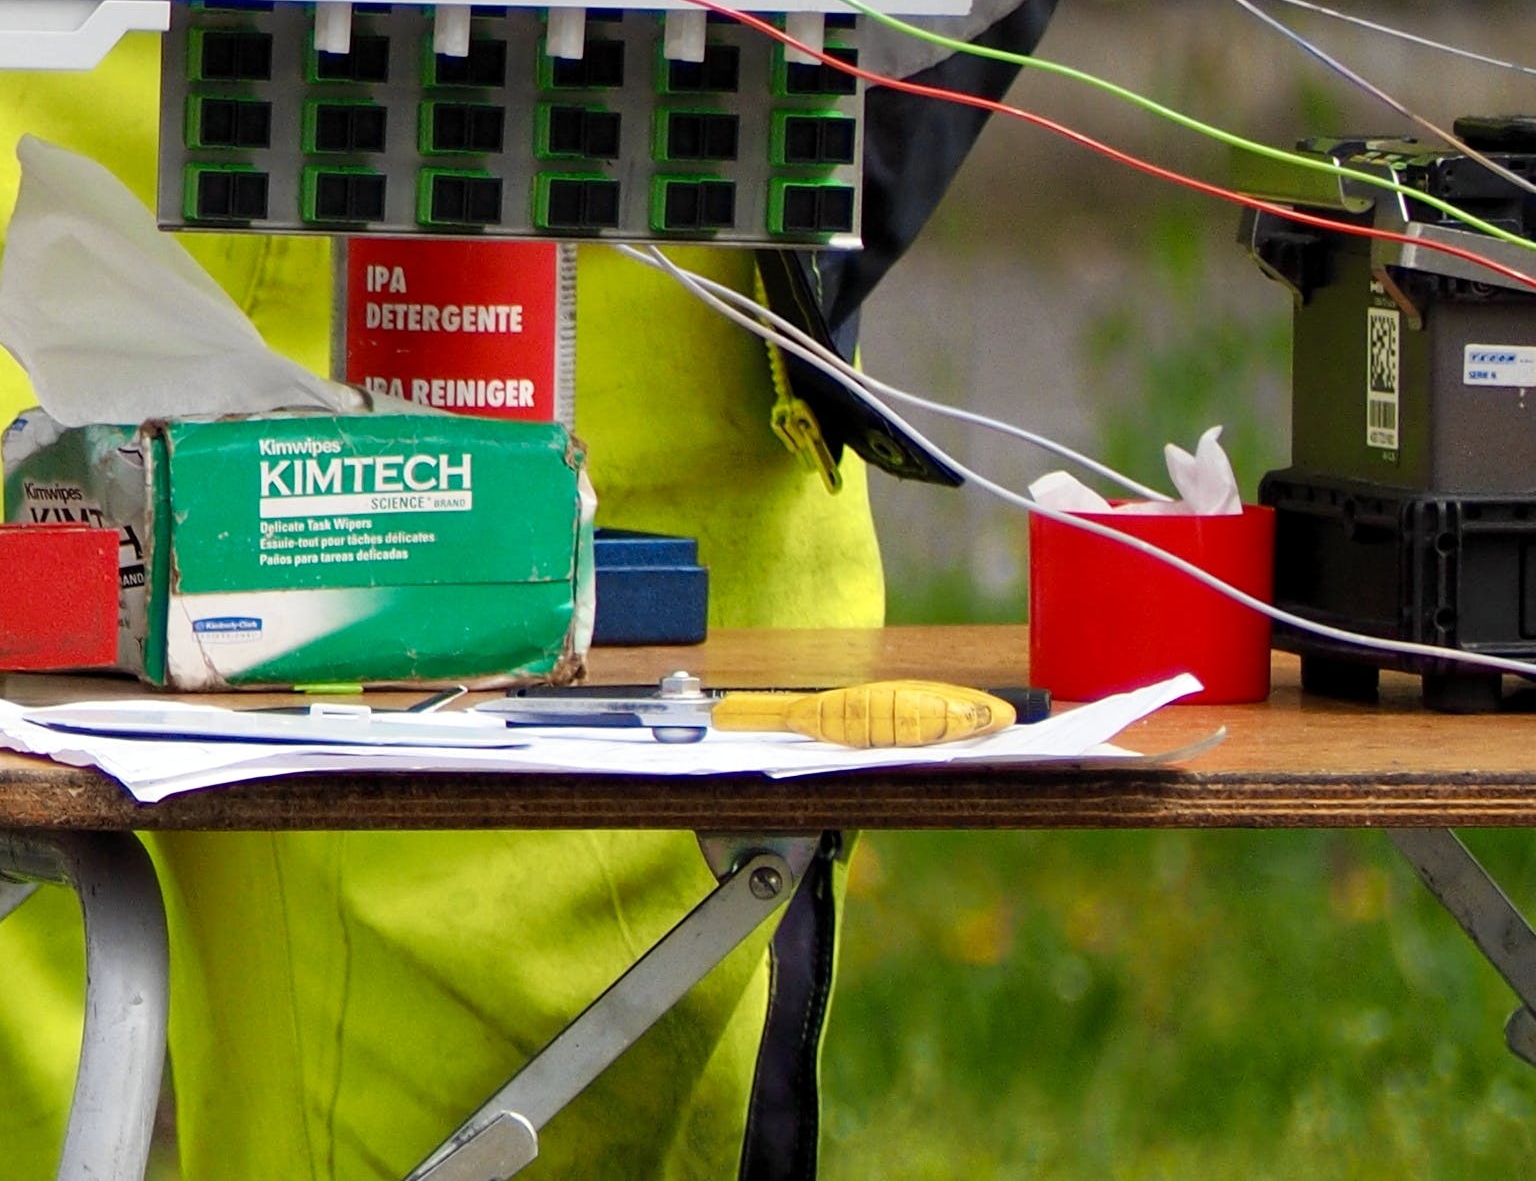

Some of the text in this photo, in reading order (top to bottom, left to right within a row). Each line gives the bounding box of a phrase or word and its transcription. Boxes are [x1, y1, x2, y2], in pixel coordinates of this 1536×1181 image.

[366, 265, 407, 293] IPA
[365, 302, 523, 333] DETERGENTE
[411, 378, 535, 407] REINIGER
[259, 437, 341, 457] Kimwipes
[259, 453, 472, 497] KIMTECH
[24, 482, 82, 504] Kimwipes
[371, 497, 466, 510] SCIENCE BRAND
[260, 517, 372, 534] Delicate Task Wipers
[260, 536, 319, 550] Essuie-tout
[321, 537, 345, 549] pour
[294, 554, 319, 567] para
[321, 552, 354, 563] tareas
[356, 548, 408, 561] delicadas
[120, 573, 144, 586] AND
